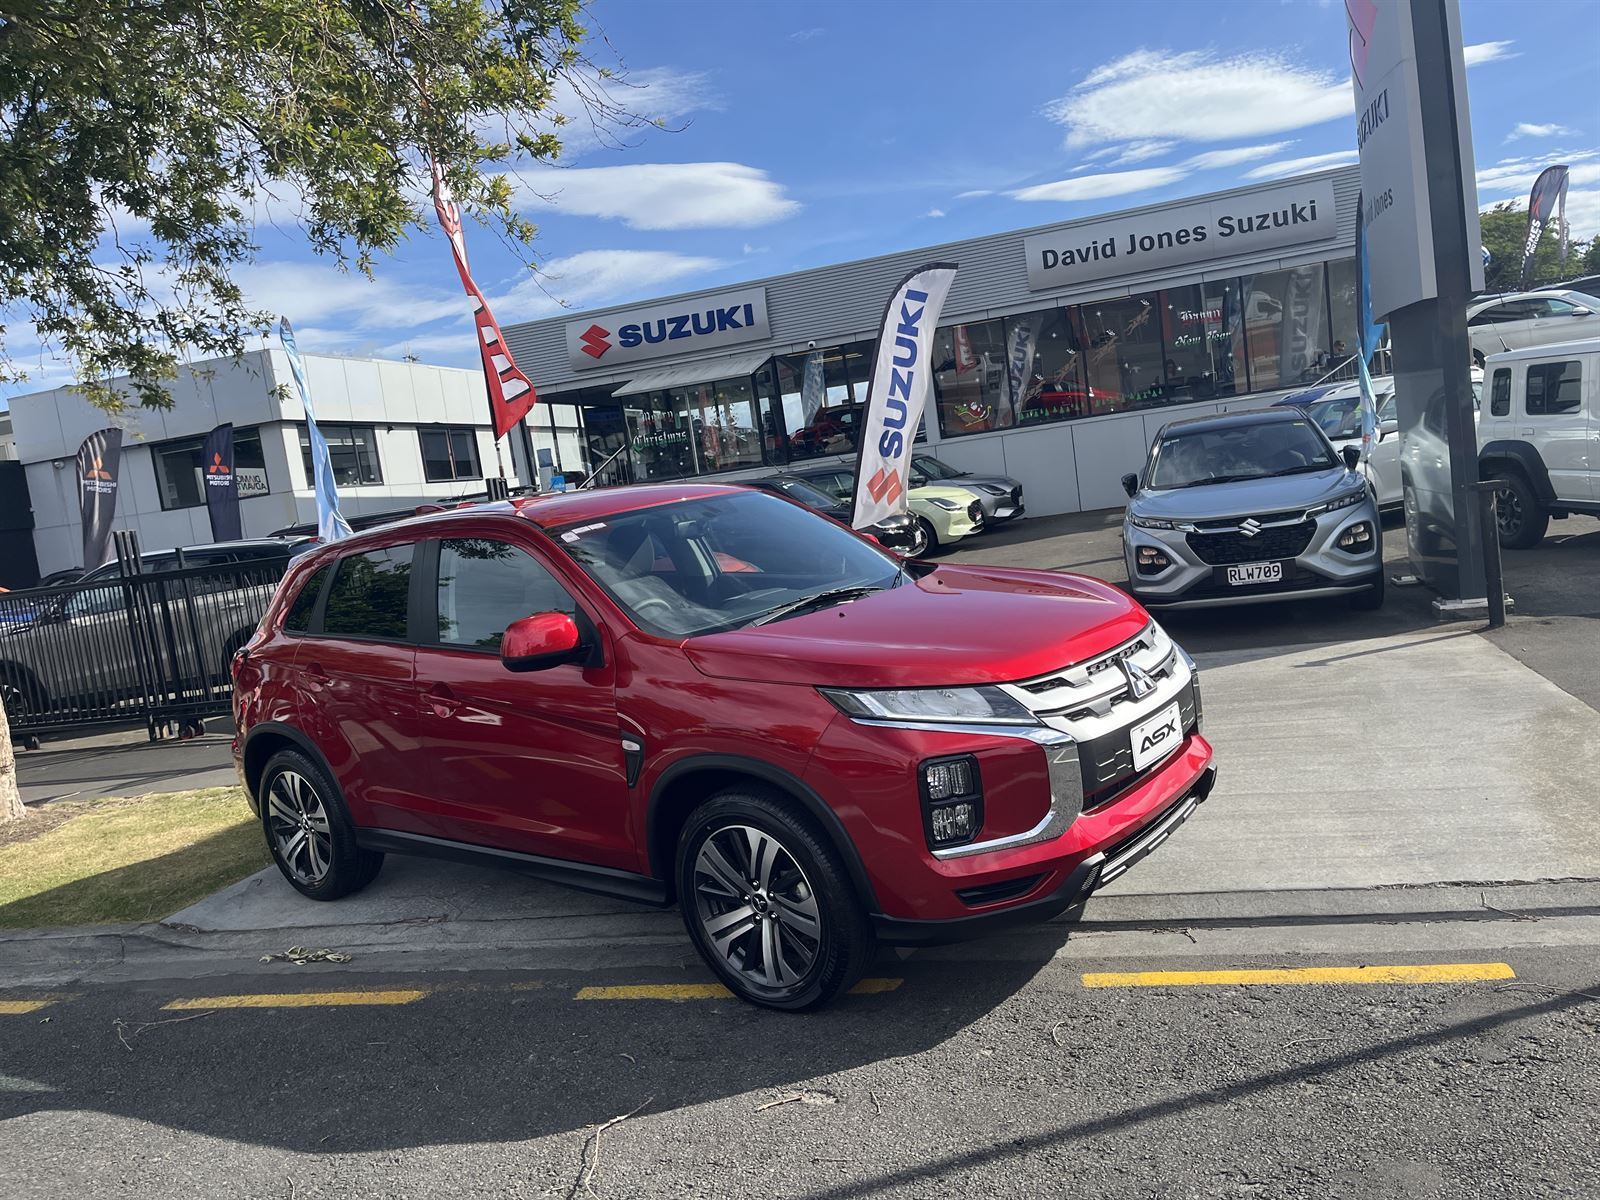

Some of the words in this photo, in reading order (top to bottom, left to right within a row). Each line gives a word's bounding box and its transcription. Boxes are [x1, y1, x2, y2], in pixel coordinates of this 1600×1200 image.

[1041, 237, 1117, 270] David
[1126, 225, 1208, 255] Jones
[1217, 200, 1318, 238] Suzuki
[617, 303, 755, 348] SUZUKI
[878, 289, 929, 460] SUZUKI
[1229, 565, 1280, 581] RLW709
[1140, 718, 1177, 755] ASX
